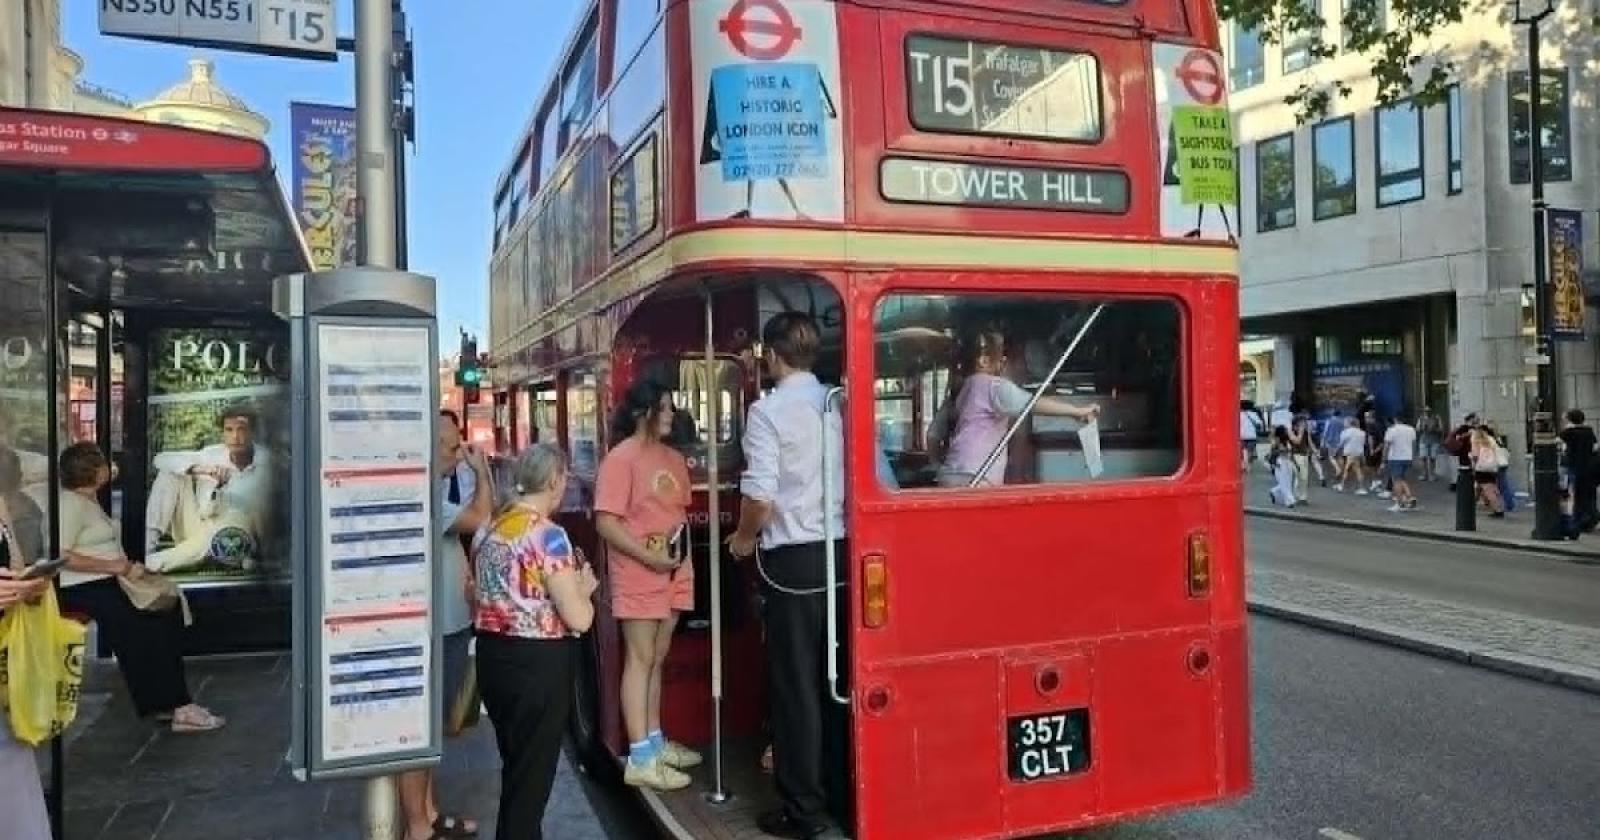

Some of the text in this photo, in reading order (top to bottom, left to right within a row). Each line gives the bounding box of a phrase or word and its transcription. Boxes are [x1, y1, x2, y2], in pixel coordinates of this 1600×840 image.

[103, 0, 253, 22] N550 N551
[268, 7, 325, 43] T15
[985, 49, 1037, 76] Trafalgar
[746, 75, 792, 89] HIRE A
[909, 51, 974, 116] T15
[740, 99, 803, 114] HISTORIC
[21, 122, 87, 140] Station
[726, 123, 819, 139] LONDON ICON
[1192, 115, 1217, 130] TAKE
[23, 139, 69, 154] Square
[1191, 156, 1210, 170] BUS
[911, 165, 1103, 204] TOWER HILL
[302, 134, 336, 271] ERCULES
[1020, 715, 1066, 745] 357
[1021, 744, 1073, 777] CLT
